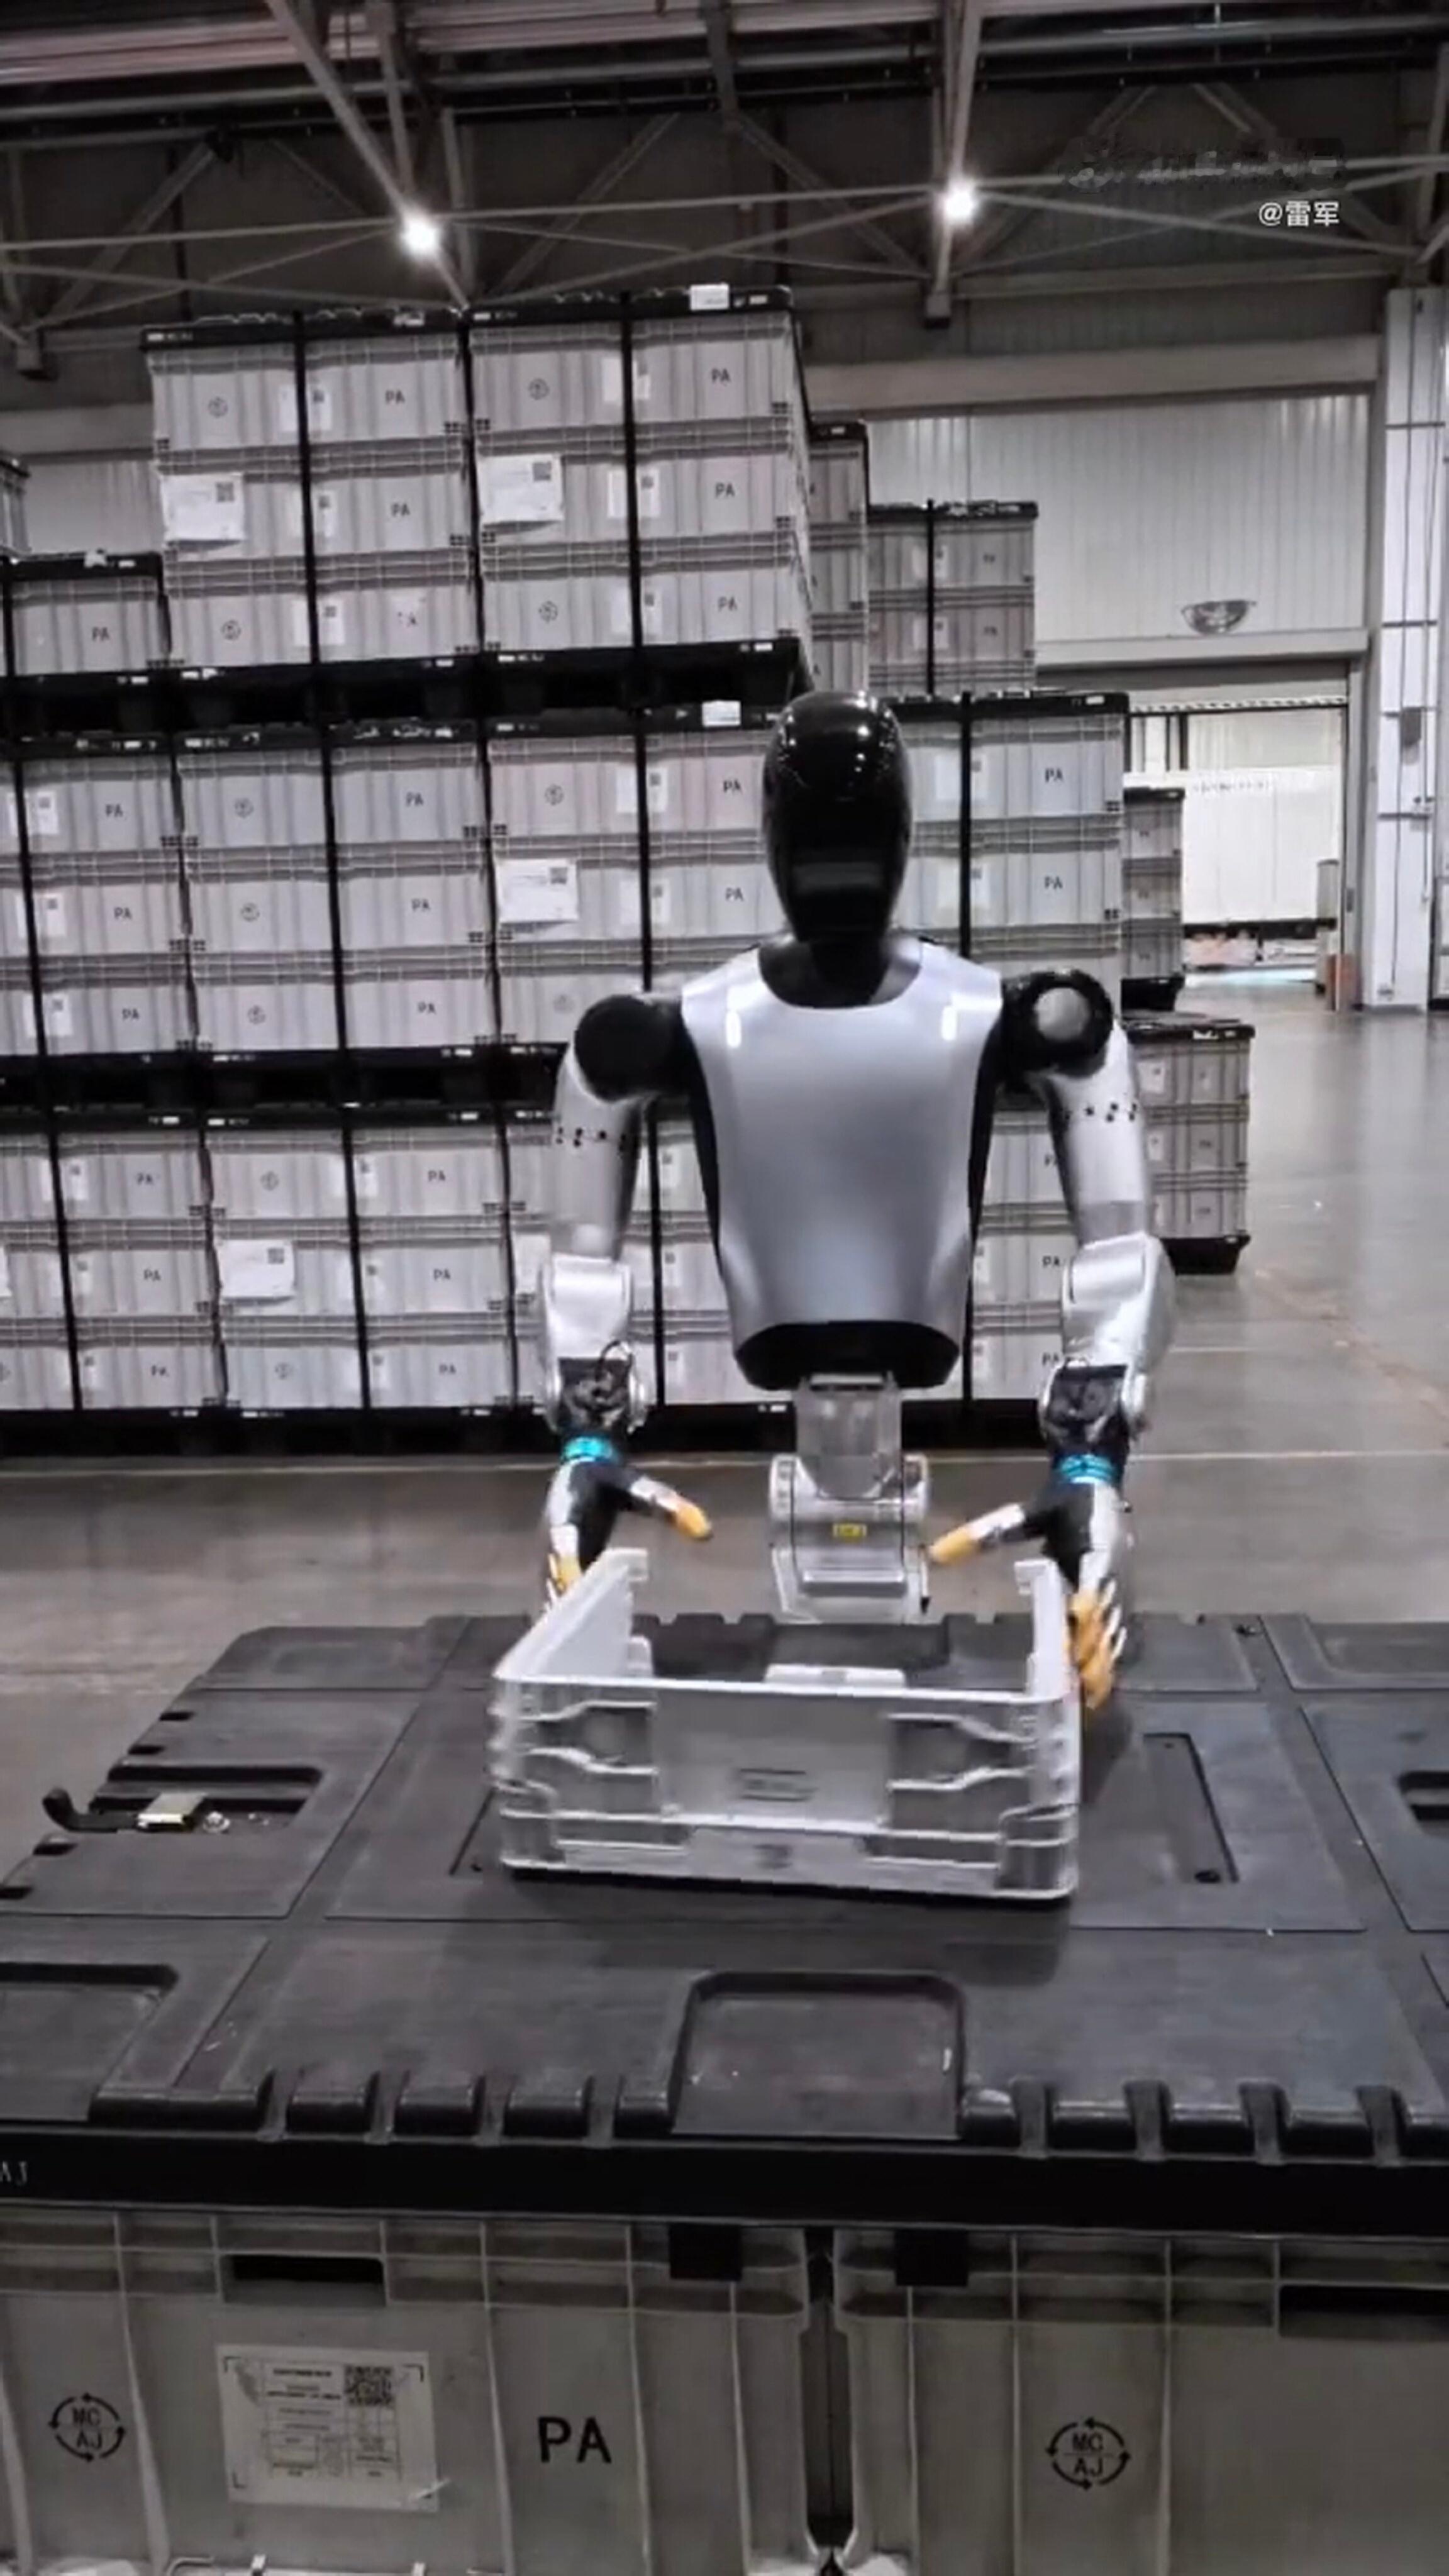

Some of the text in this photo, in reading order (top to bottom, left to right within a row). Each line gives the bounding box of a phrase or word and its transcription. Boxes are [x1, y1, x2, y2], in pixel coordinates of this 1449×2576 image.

[711, 369, 730, 382] PA
[386, 391, 405, 404] PA
[716, 483, 735, 497] PA
[392, 503, 411, 516] PA
[1045, 769, 1063, 782] PA
[723, 780, 742, 792] PA
[406, 792, 424, 806] PA
[1045, 877, 1063, 889] PA
[114, 906, 131, 919] PA
[72, 2407, 101, 2426] MC
[76, 2431, 103, 2449] AJ
[538, 2416, 612, 2463] PA
[1072, 2433, 1104, 2451] MC
[1074, 2458, 1103, 2476] AJ
